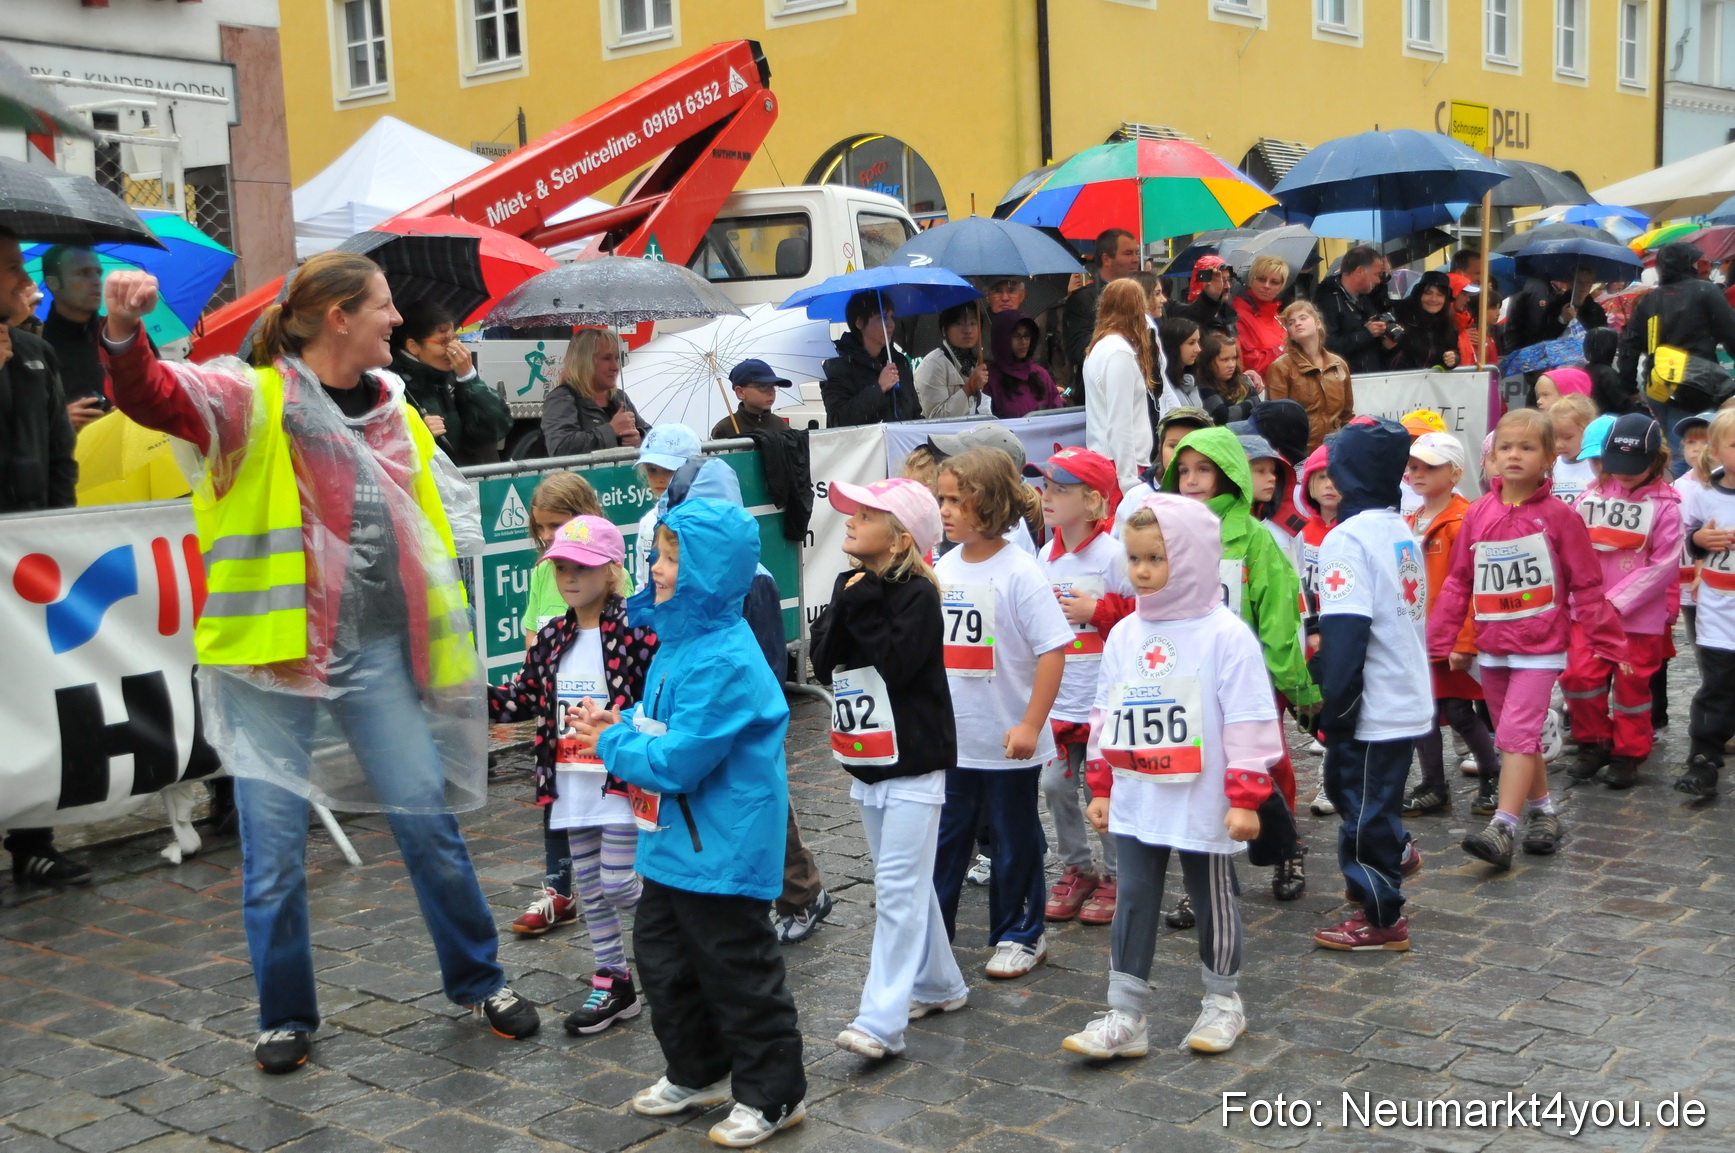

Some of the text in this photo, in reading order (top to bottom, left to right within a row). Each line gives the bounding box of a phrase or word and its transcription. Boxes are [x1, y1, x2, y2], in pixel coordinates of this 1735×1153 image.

[1453, 120, 1486, 138] Schnupper-
[1493, 108, 1530, 150] DELI
[476, 147, 507, 157] RATHAUS
[485, 81, 722, 228] Miet- & Serviceline. 09181 6352
[1614, 437, 1640, 446] SPORT
[1583, 501, 1643, 530] 7183
[1478, 557, 1542, 592] 7045
[1499, 597, 1522, 610] Mia
[947, 609, 983, 643] 79
[1141, 636, 1176, 658] DEUTSCHES
[1150, 662, 1175, 679] KREUZ
[834, 695, 880, 733] 02
[1111, 705, 1188, 746] 7156
